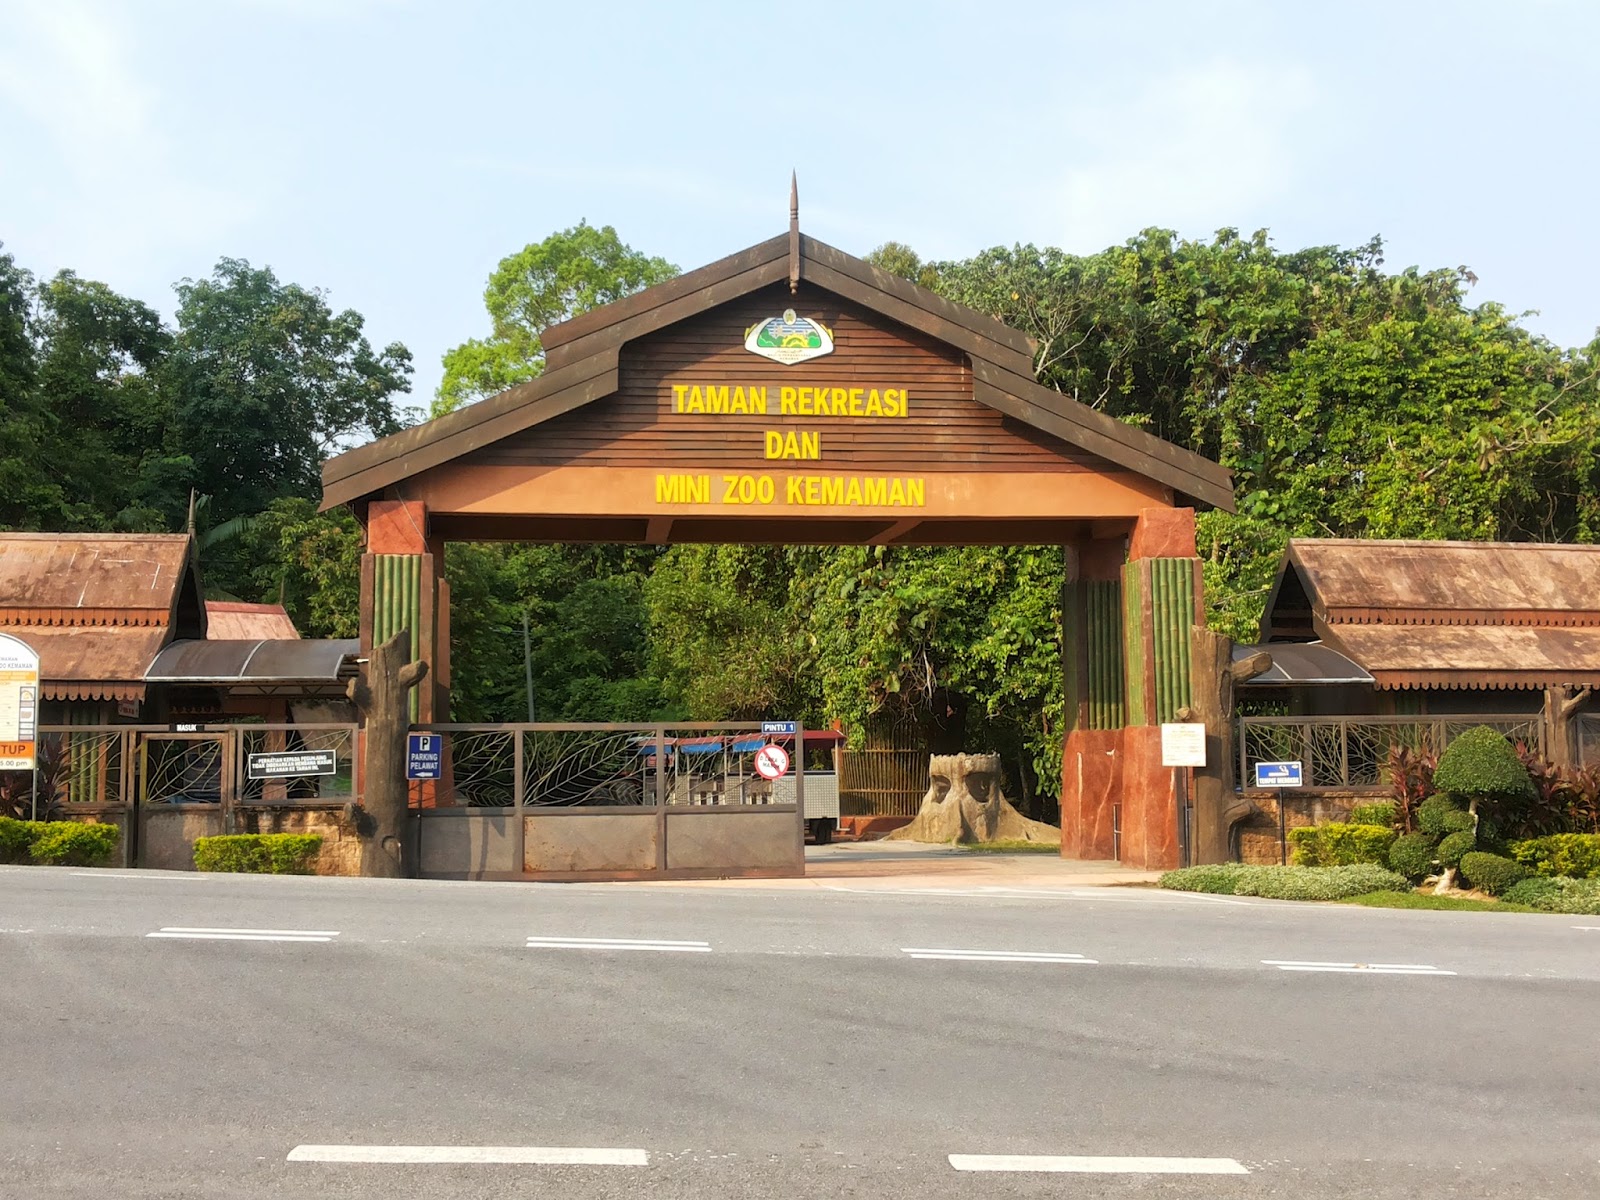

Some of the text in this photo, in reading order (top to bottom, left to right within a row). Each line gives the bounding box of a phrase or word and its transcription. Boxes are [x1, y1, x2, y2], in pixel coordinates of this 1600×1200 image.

[672, 384, 908, 418] TAMAN REKREASI
[765, 431, 820, 460] DAN
[655, 474, 925, 507] MINI ZOO KEMAMAN
[176, 724, 197, 732] MASUK
[764, 723, 794, 731] PINTU 1
[1, 744, 26, 755] TUP
[422, 737, 429, 750] P
[410, 753, 438, 761] PARKING
